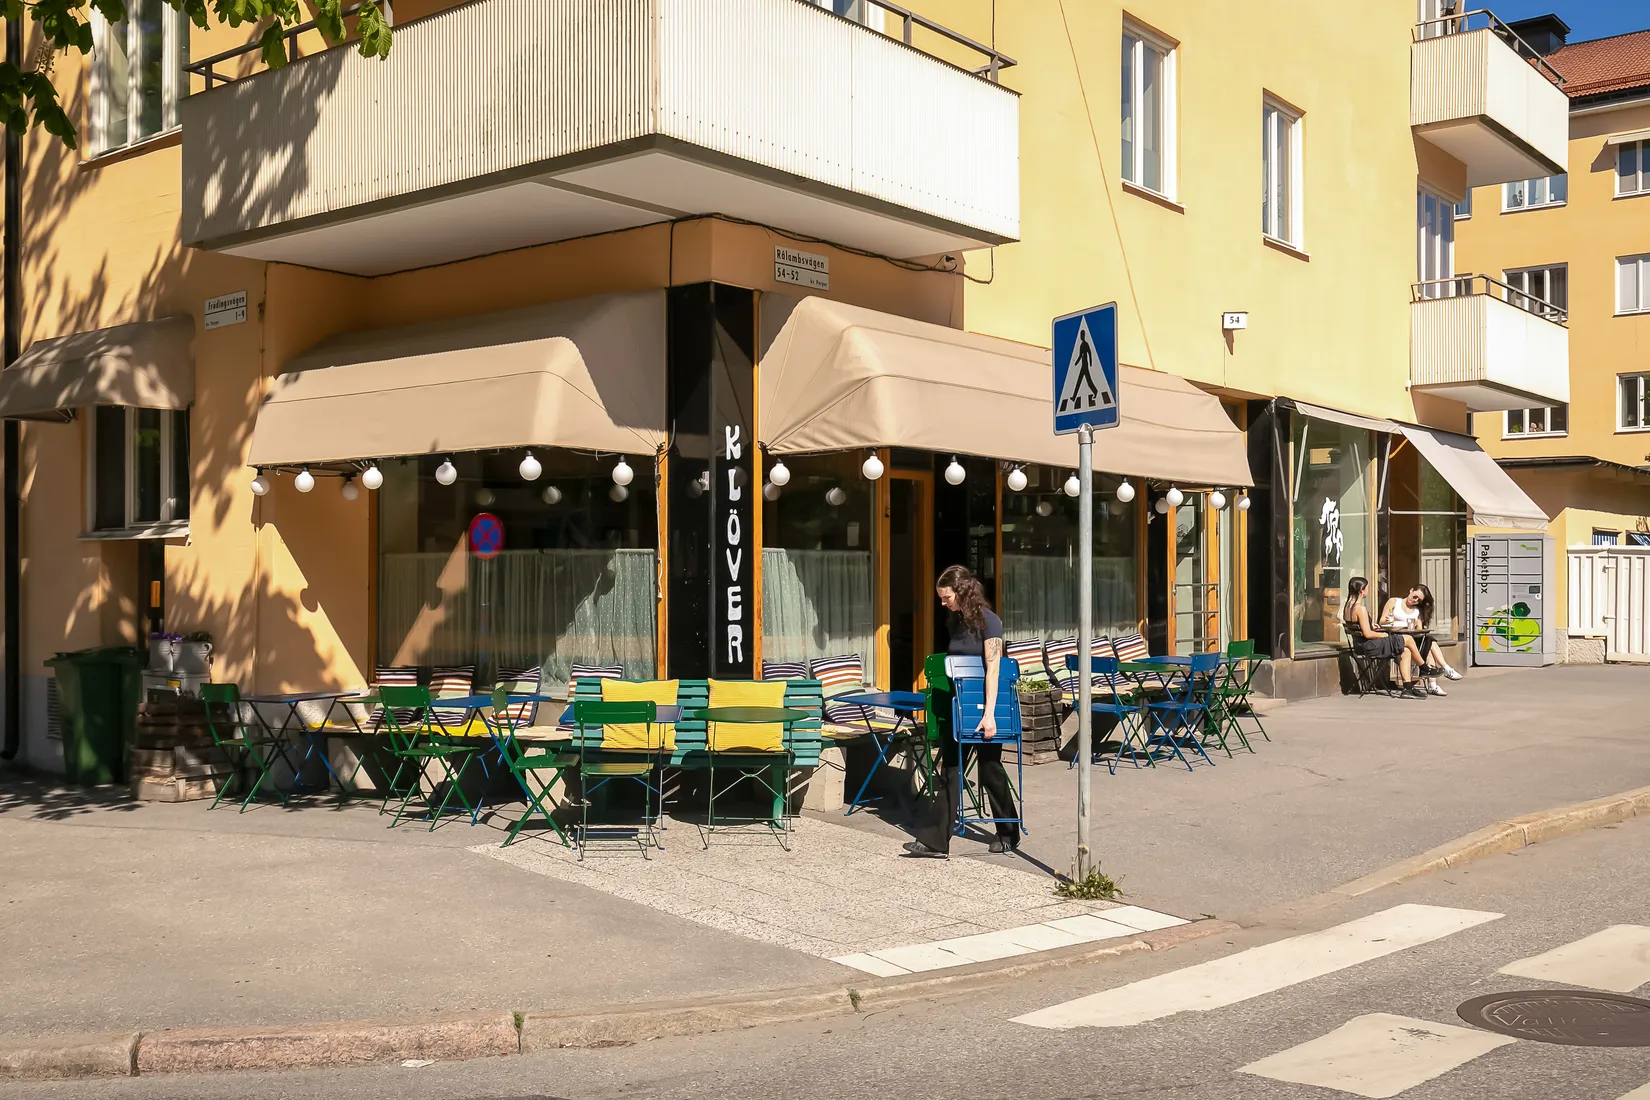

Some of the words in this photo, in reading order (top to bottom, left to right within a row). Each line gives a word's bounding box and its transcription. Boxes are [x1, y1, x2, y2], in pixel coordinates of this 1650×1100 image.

[776, 248, 825, 269] Rålambsvägen
[777, 267, 799, 281] 54-52
[207, 296, 245, 311] Frödingsvägen
[1229, 316, 1240, 324] 54
[725, 425, 743, 663] KLÖVER
[1480, 544, 1490, 594] Paketbox
